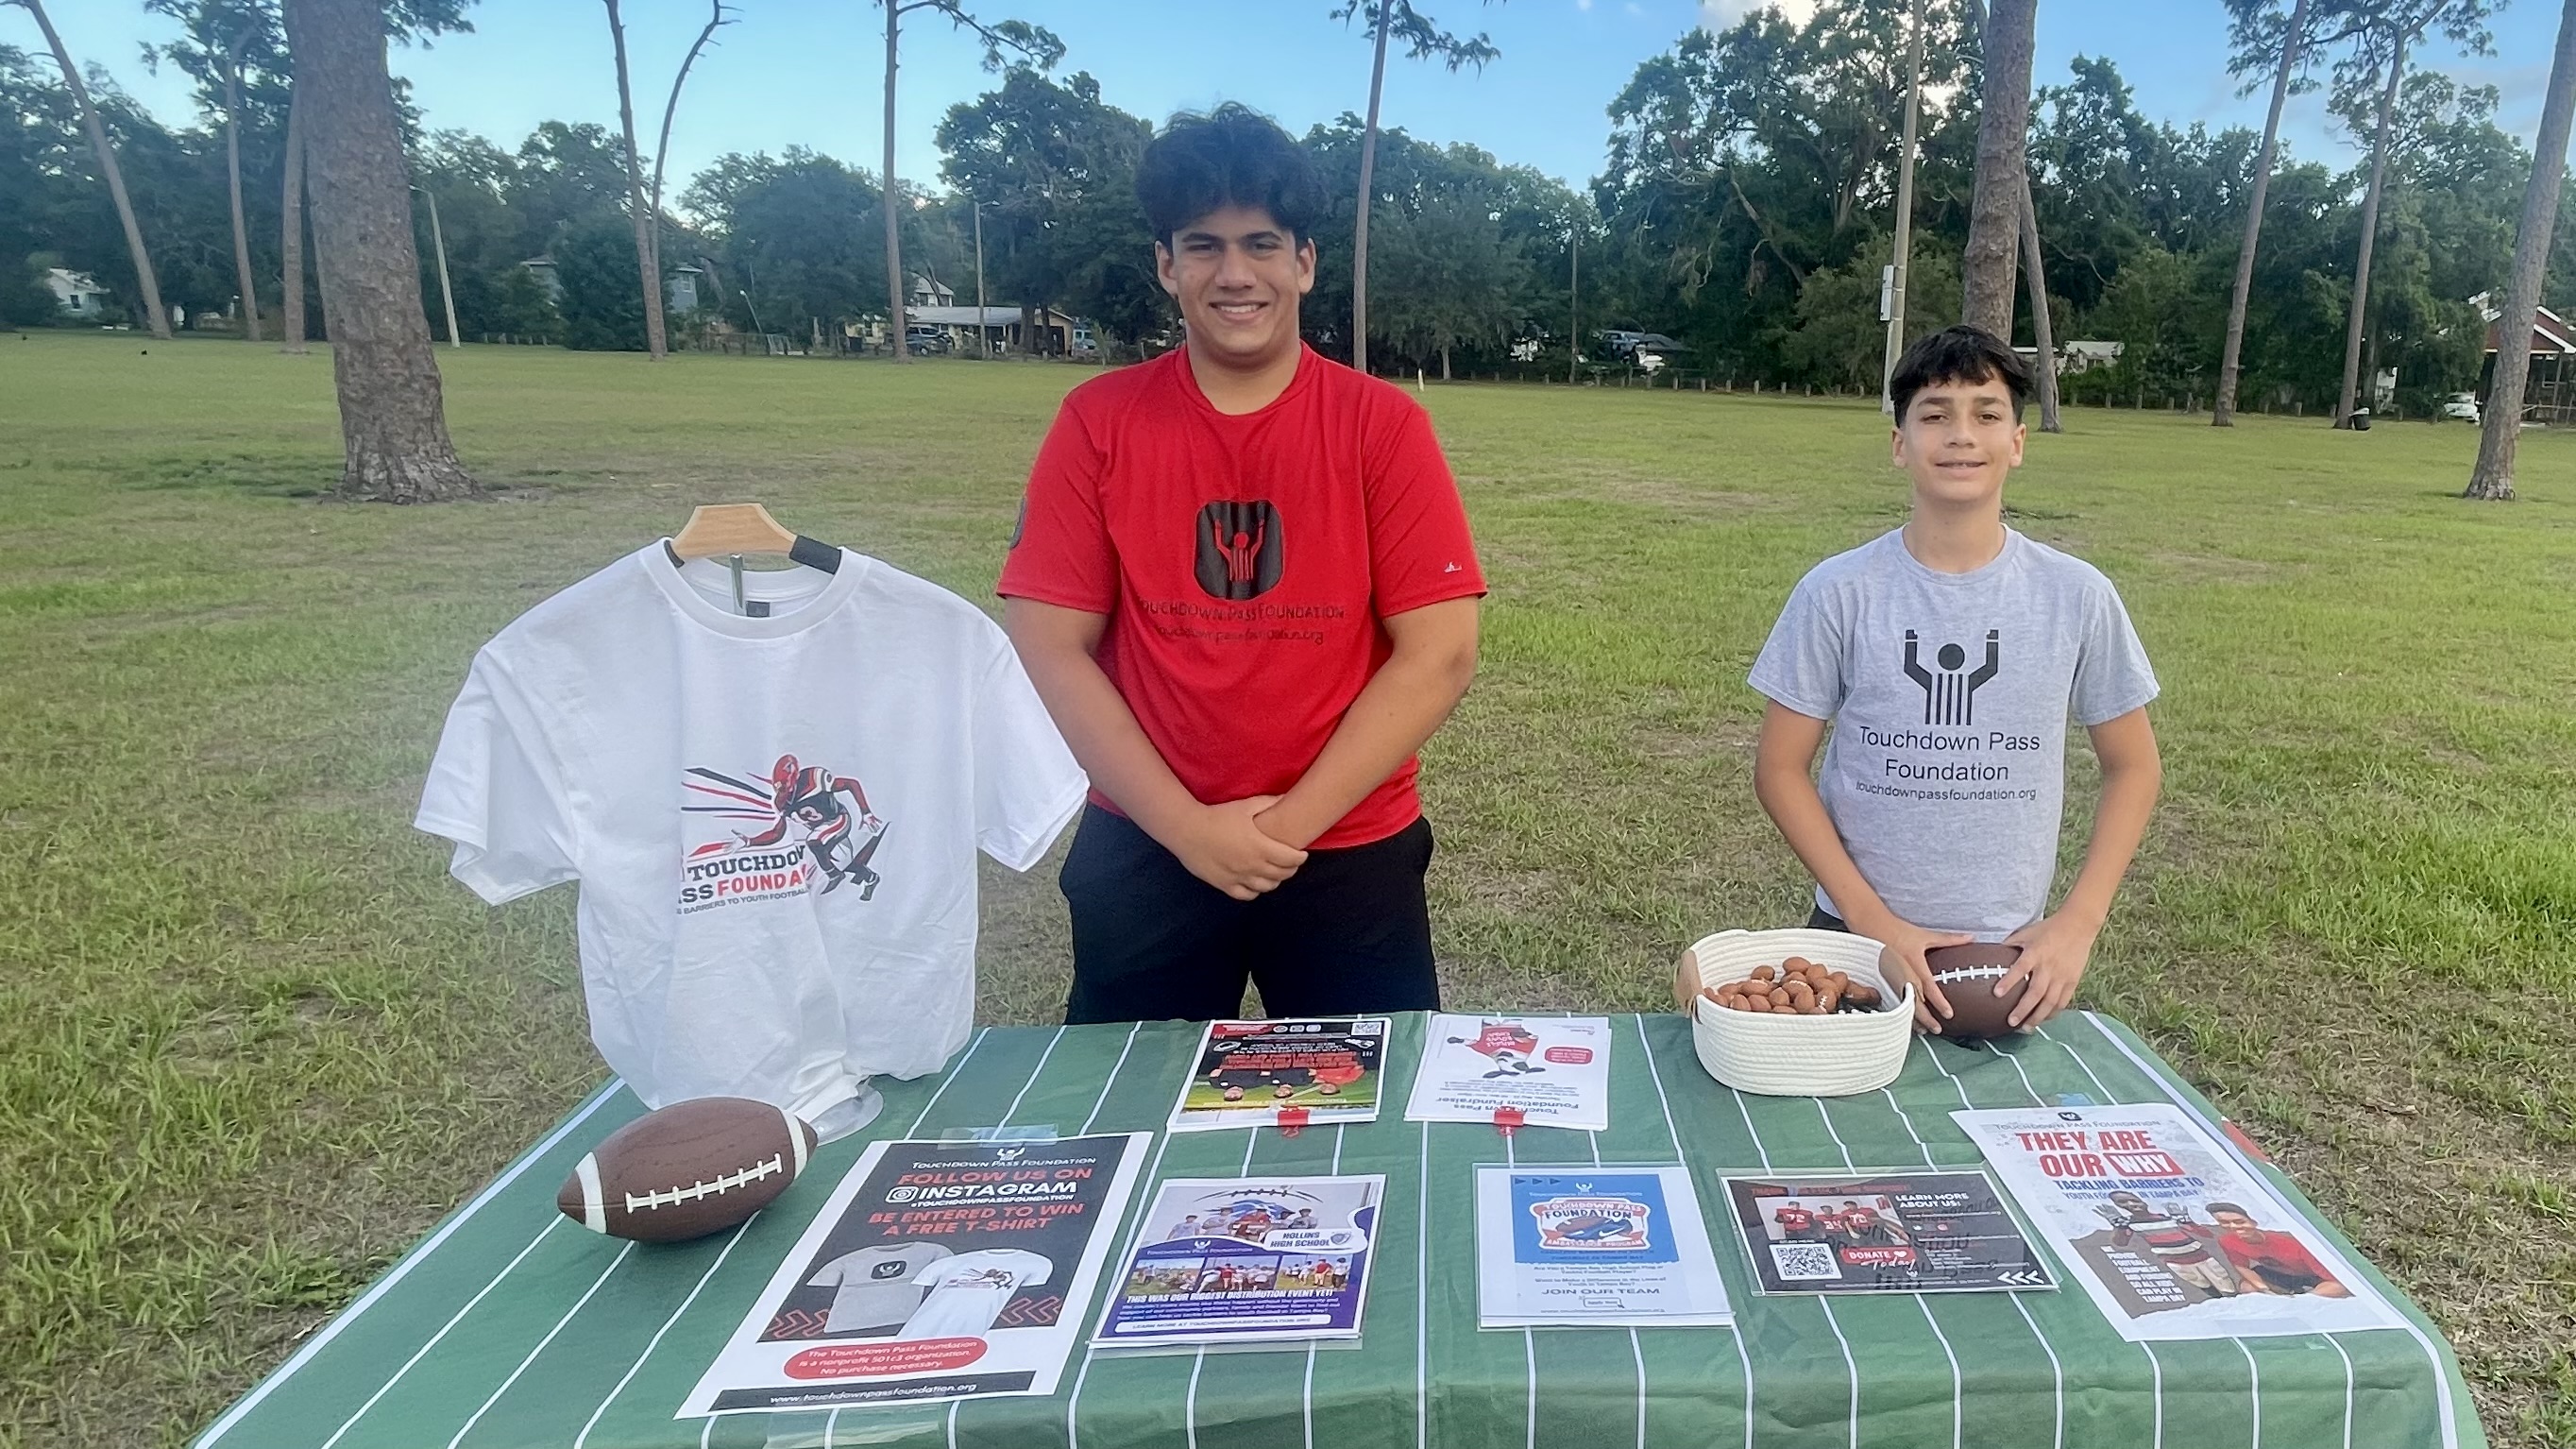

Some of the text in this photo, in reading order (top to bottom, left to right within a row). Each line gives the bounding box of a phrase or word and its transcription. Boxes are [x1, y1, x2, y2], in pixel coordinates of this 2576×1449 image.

[1859, 725, 2041, 751] Touchdown Pass
[1886, 759, 2009, 781] Foundation
[1856, 780, 2037, 801] touchdownpassfoundation.org
[677, 863, 807, 904] SS FOUNDA
[727, 896, 739, 906] TO
[740, 893, 770, 905] YOUTH
[1436, 1097, 1579, 1110] Foundation Fundraiser
[2015, 1130, 2158, 1151] THEY ARE
[912, 1161, 989, 1169] TOUCHDOWN
[1022, 1158, 1096, 1168] FOUNDATION
[2039, 1152, 2173, 1177] OUR WHY
[899, 1168, 1093, 1185] FOLLOW US ON
[2053, 1177, 2205, 1190] TACKLING BARRIERS TO
[919, 1182, 1077, 1200] INSTAGRAM
[1895, 1192, 1970, 1202] LEARN MORE
[869, 1203, 1085, 1224] BE ENTERED TO WIN
[1544, 1208, 1633, 1219] FOUNDATION
[883, 1218, 1052, 1236] A FREE T-SHIRT
[1848, 1250, 1891, 1259] DONATE
[1860, 1257, 1916, 1270] Today
[1127, 1295, 1147, 1304] THIS
[1149, 1294, 1169, 1303] WAS
[1227, 1289, 1286, 1300] DISTRIBUTION
[1287, 1288, 1315, 1298] EVENT
[918, 1341, 978, 1352] Foundation
[838, 1365, 889, 1375] purchase
